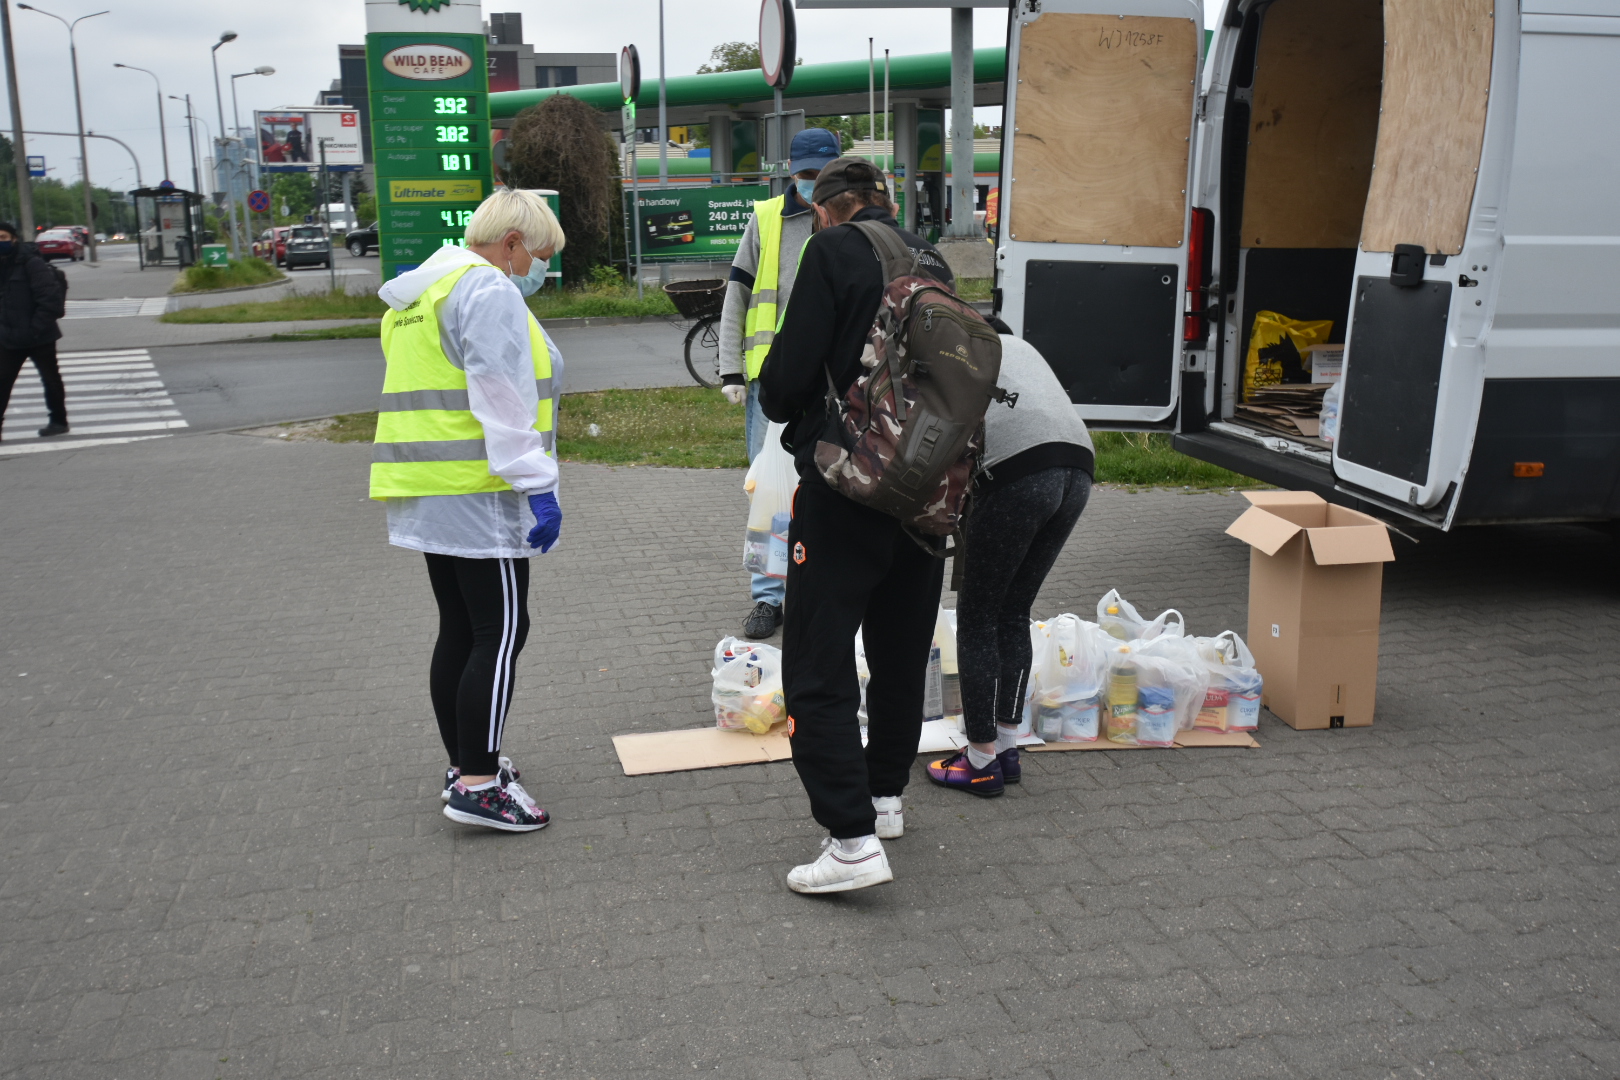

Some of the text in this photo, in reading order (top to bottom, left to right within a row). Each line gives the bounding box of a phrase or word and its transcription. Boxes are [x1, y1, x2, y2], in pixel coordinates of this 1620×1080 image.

[393, 55, 463, 67] WILD BEAN
[394, 187, 446, 198] ultimate
[645, 198, 681, 206] handlowy
[709, 211, 728, 221] 240
[730, 210, 740, 220] zł
